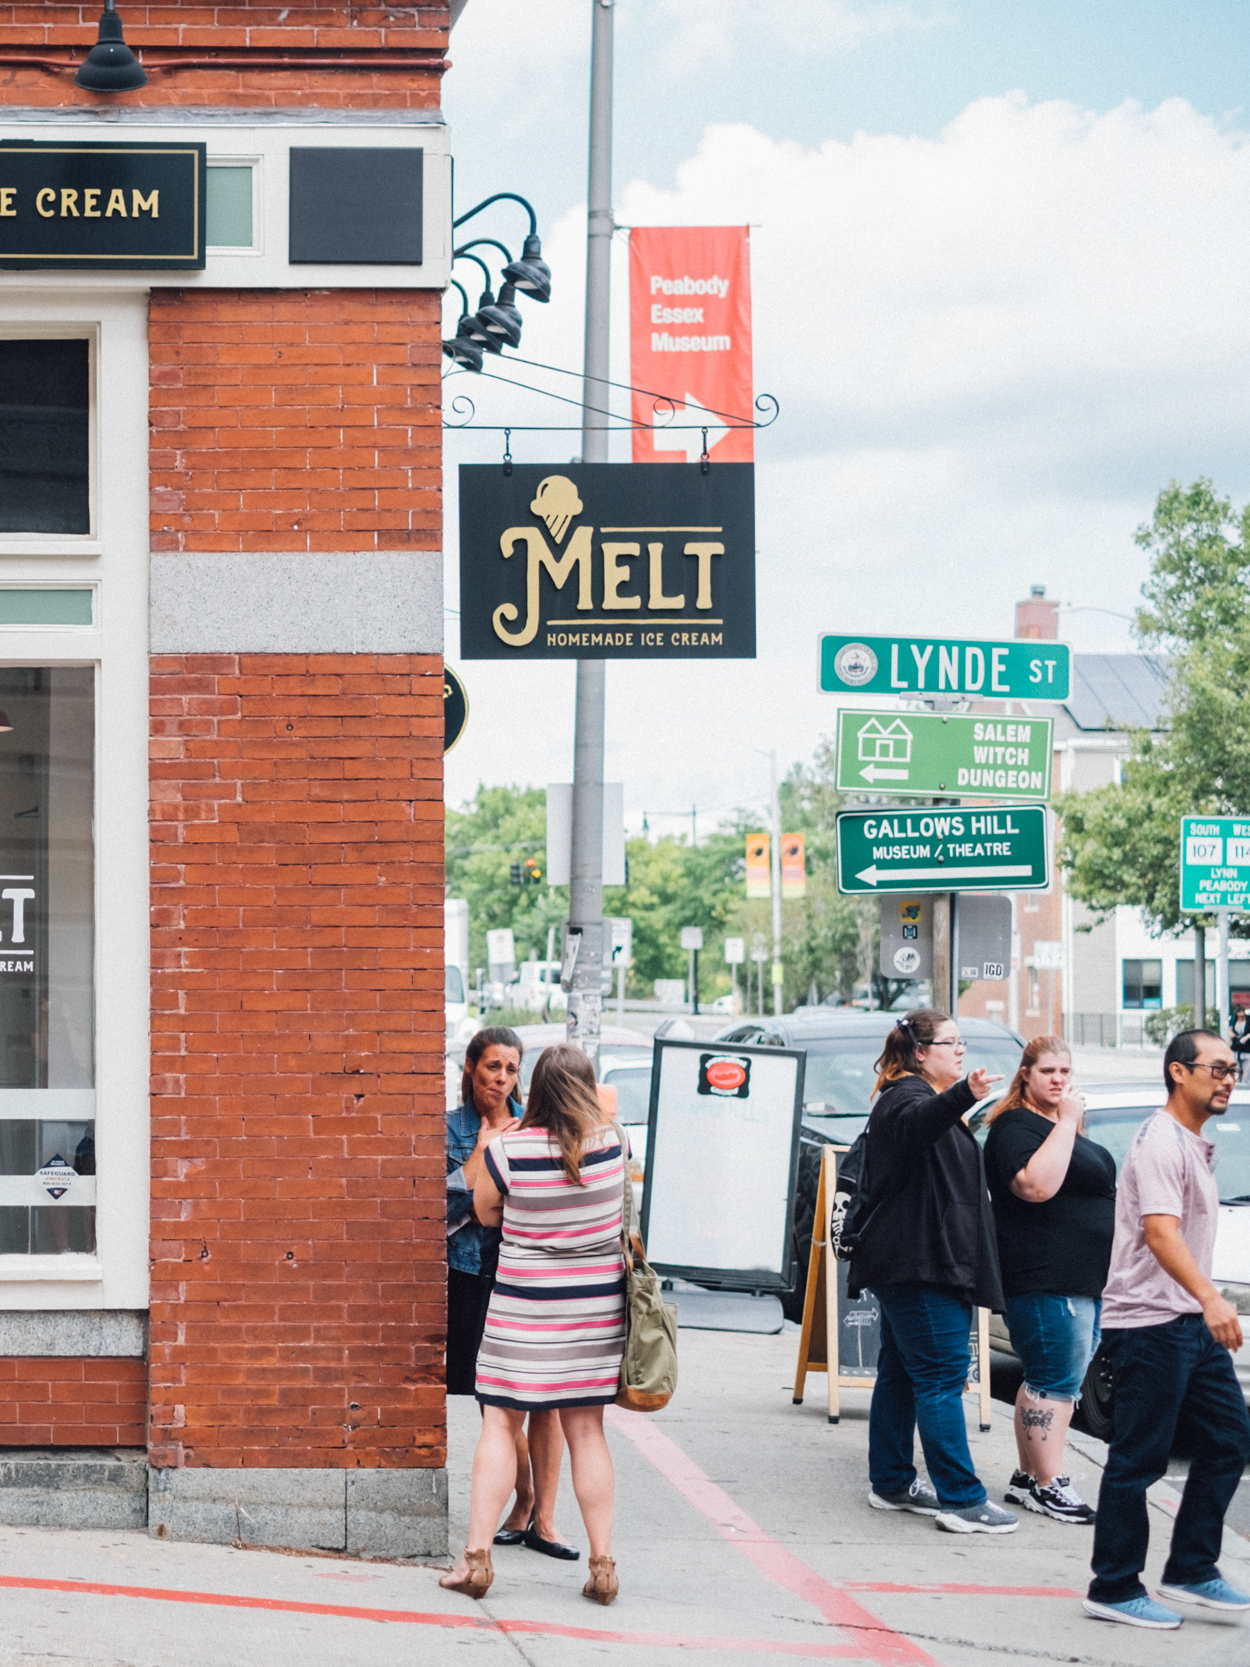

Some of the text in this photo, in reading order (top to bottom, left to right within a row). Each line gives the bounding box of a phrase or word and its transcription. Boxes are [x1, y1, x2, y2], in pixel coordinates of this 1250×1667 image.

[34, 187, 161, 219] CREAM
[650, 275, 729, 297] Peabody
[651, 304, 704, 324] Essex
[651, 333, 731, 352] Museum
[492, 525, 725, 647] MELT
[546, 632, 723, 647] HOMEMADE ICE CREAM
[890, 643, 1011, 692] LYNDE
[1029, 660, 1058, 684] ST
[973, 722, 1031, 743] SALEM
[973, 745, 1029, 766] WITCH
[957, 768, 1043, 790] DUNGEON
[863, 815, 1019, 840] GALLOWS HILL
[1190, 822, 1220, 836] SOUTH
[872, 843, 931, 860] MUSEUM
[947, 841, 1012, 858] THEATRE
[1193, 844, 1216, 857] 107
[1210, 867, 1238, 879] LYNN
[1199, 879, 1248, 892] PEABODY
[1195, 892, 1221, 905] NEXT
